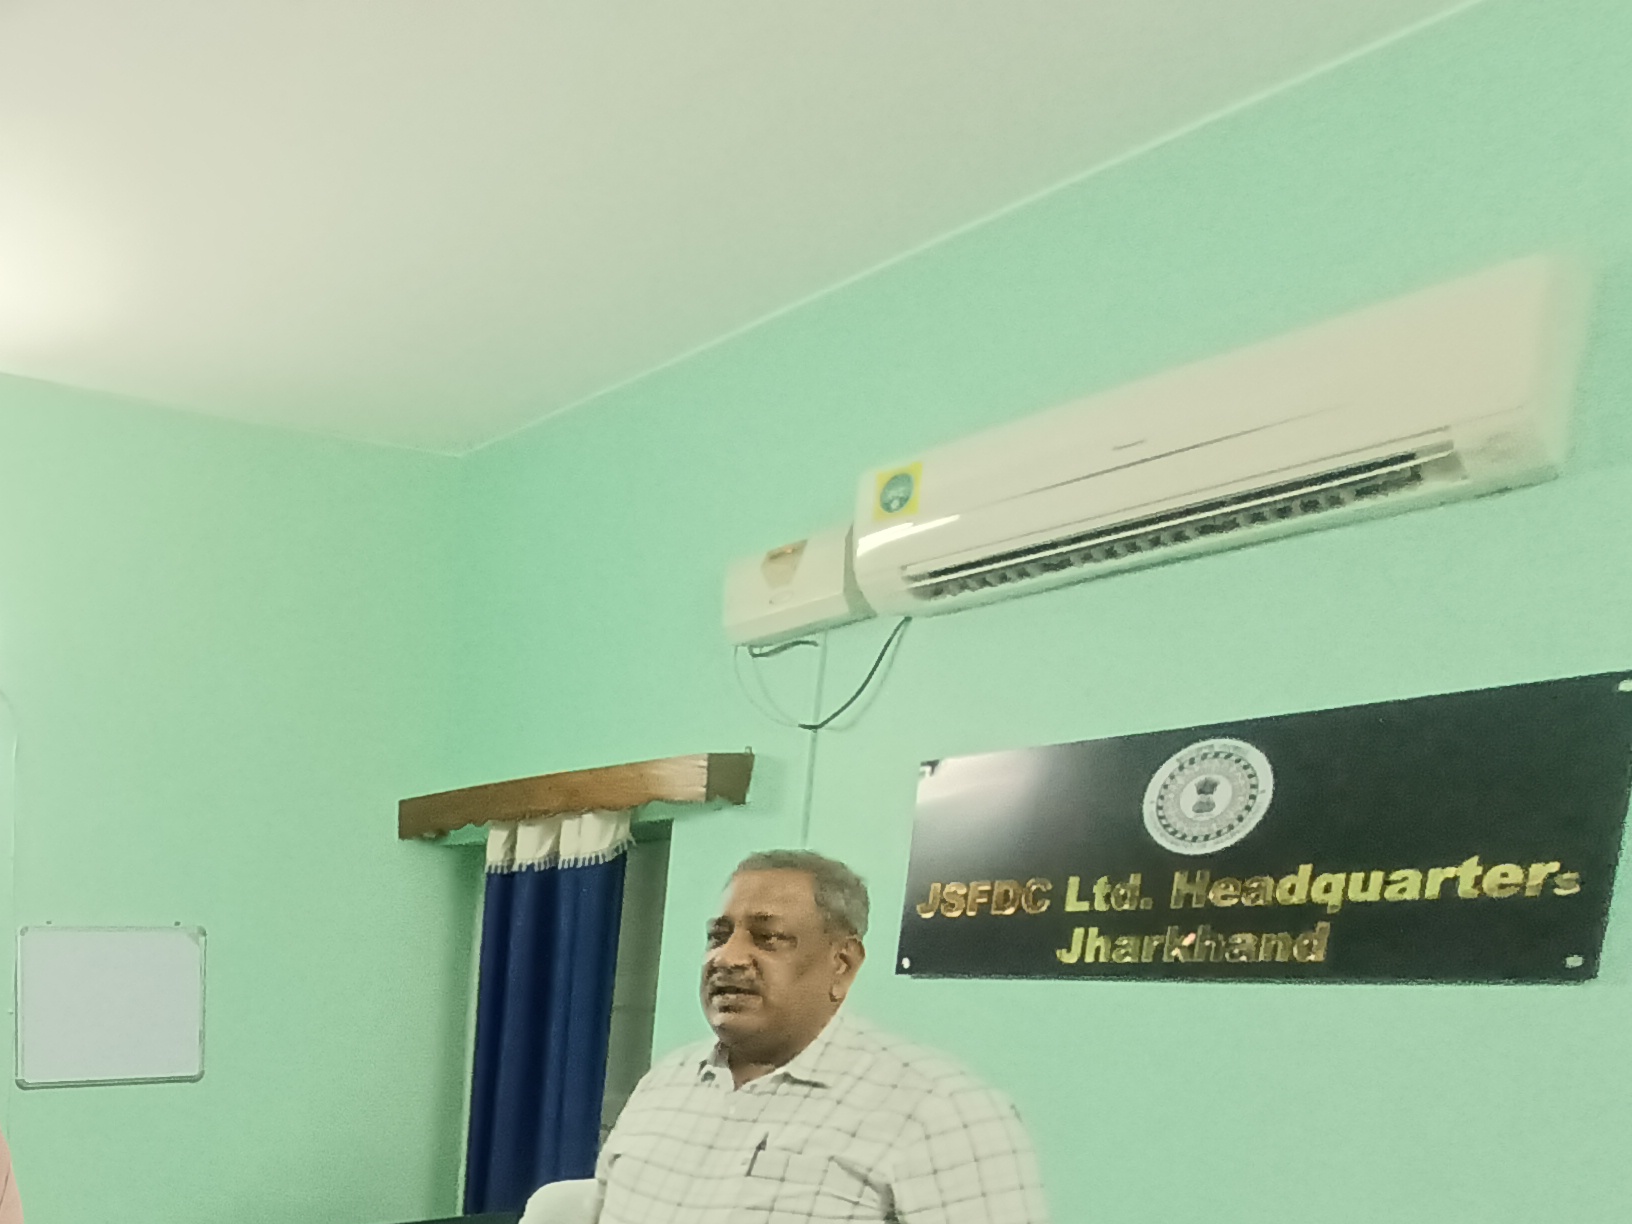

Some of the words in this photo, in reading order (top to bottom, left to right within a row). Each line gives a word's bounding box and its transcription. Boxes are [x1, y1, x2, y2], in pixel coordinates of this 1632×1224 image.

[916, 877, 1053, 919] JSFDC
[1065, 872, 1153, 912] Ltd.
[1170, 855, 1581, 914] Headquarters
[1056, 920, 1331, 964] Jharkhand
